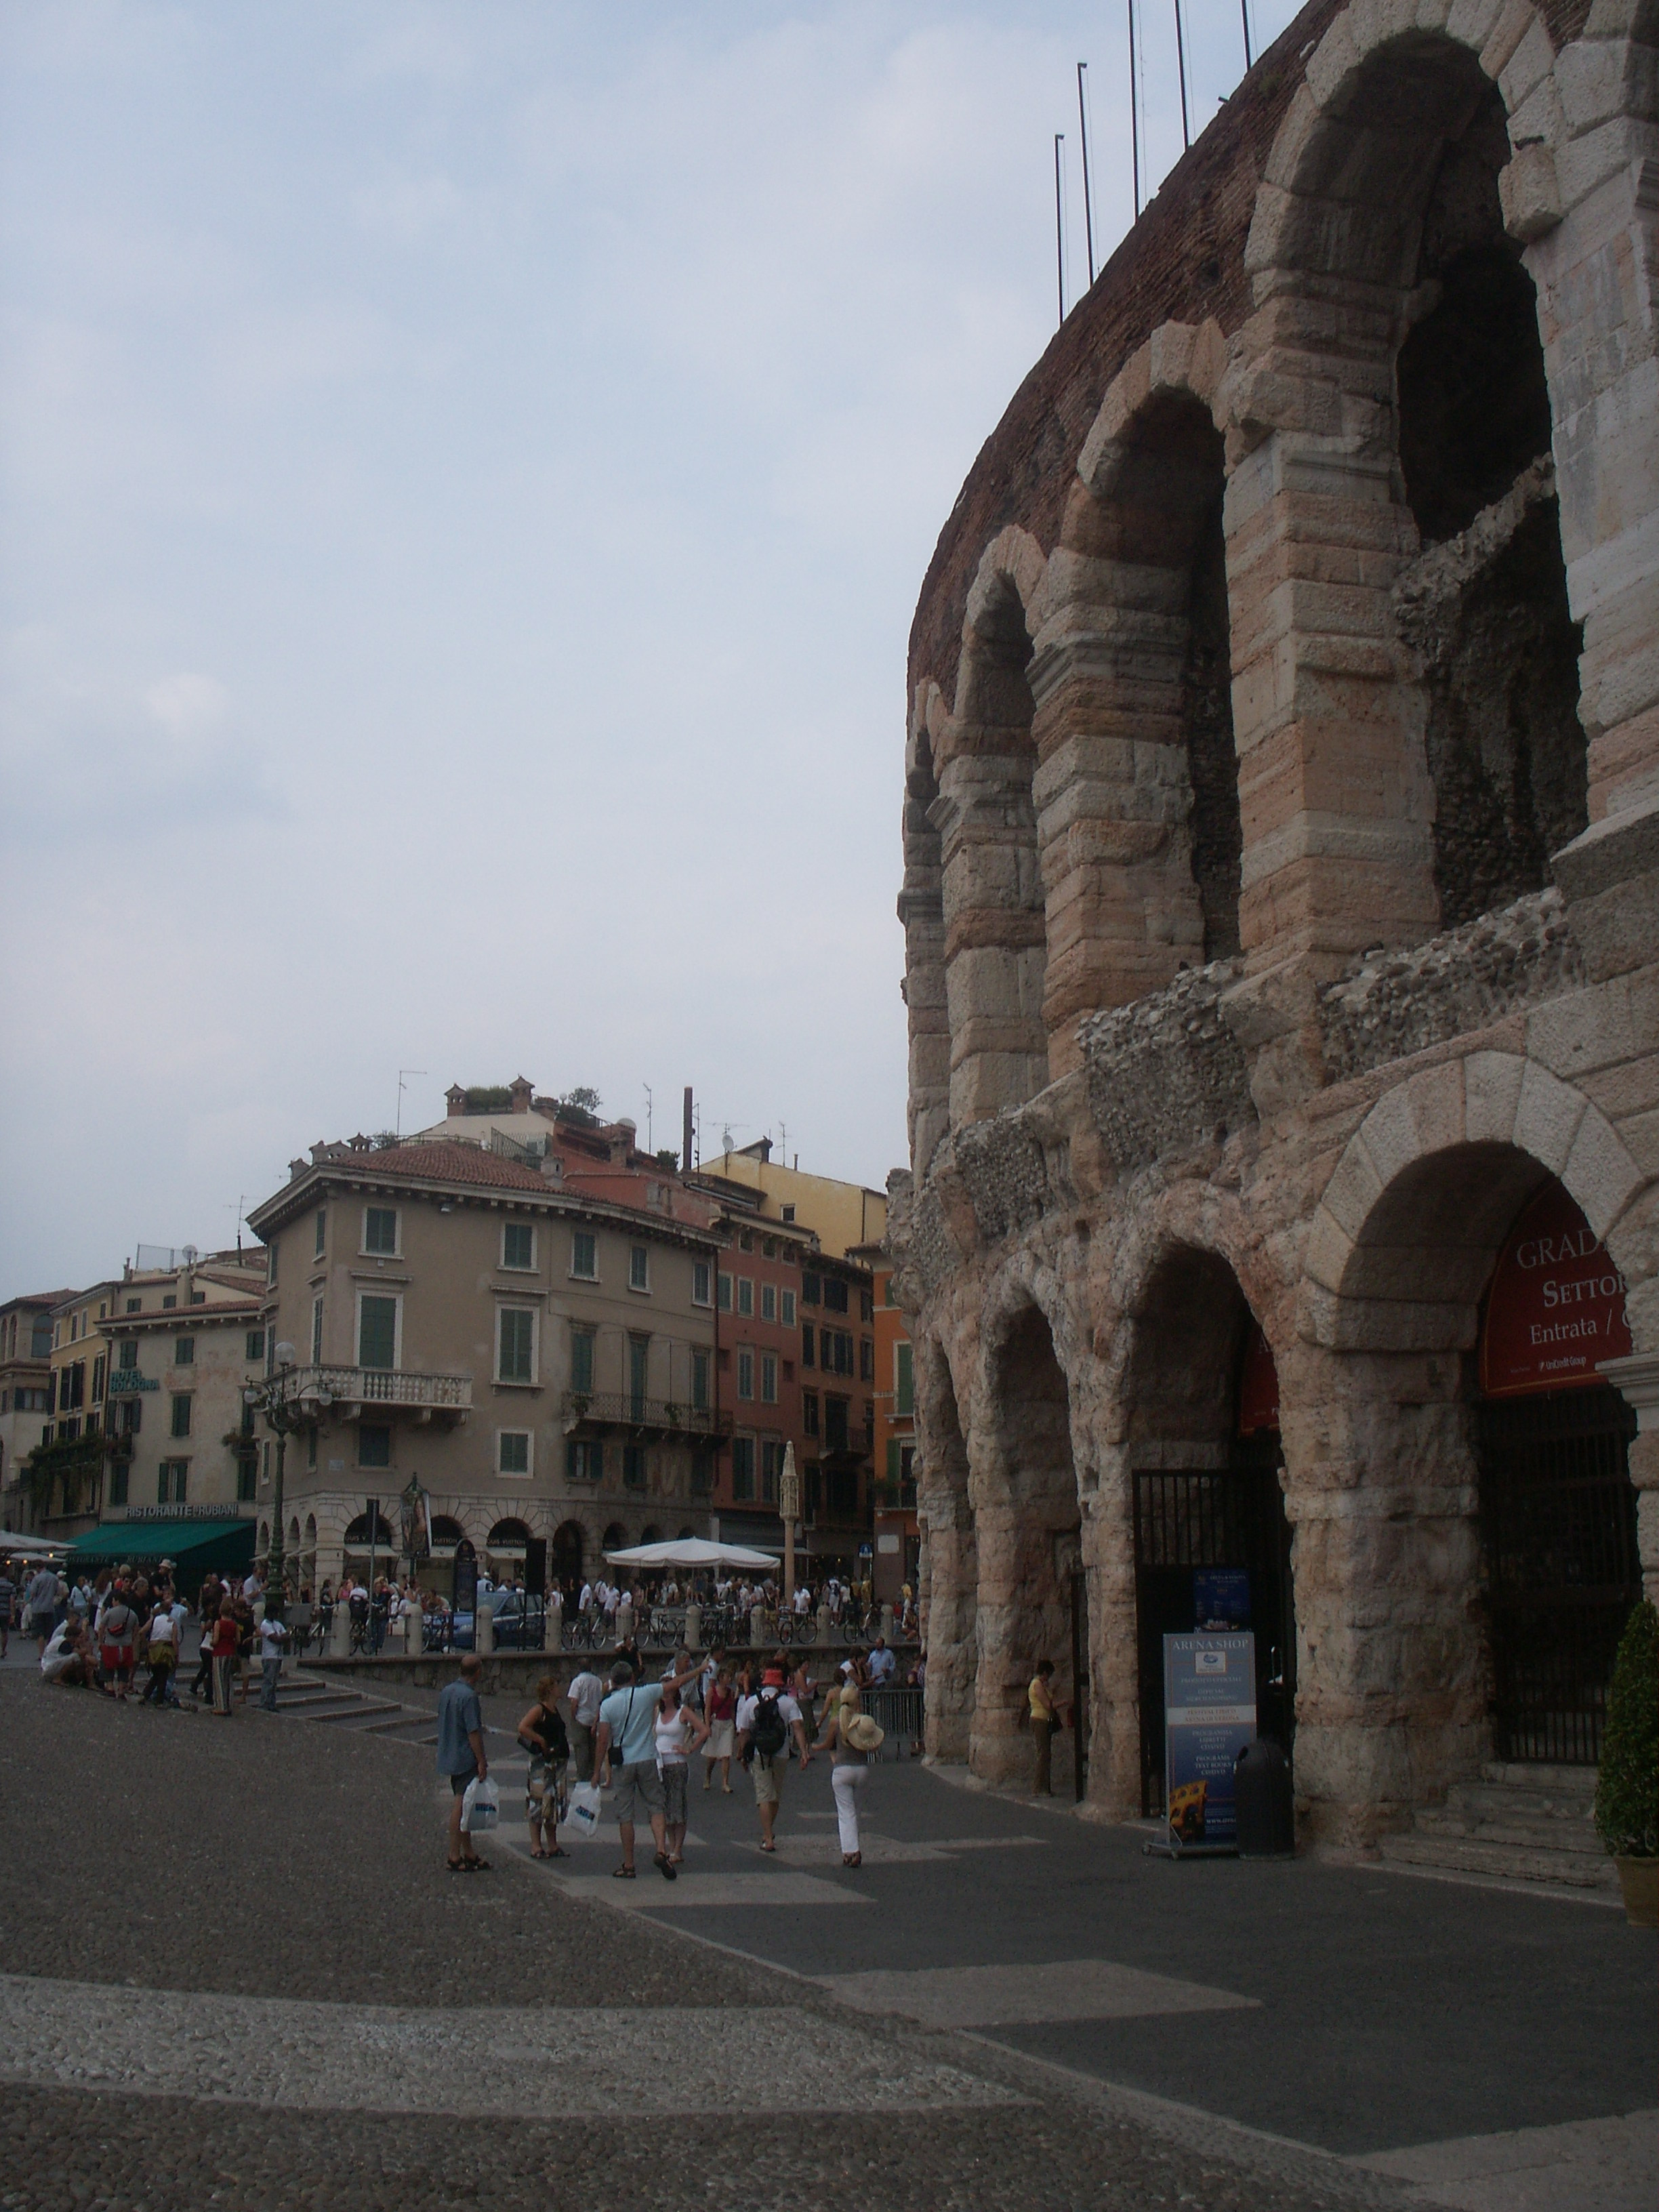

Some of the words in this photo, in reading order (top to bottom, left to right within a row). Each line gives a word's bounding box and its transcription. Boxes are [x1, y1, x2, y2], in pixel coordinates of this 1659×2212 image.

[1517, 1228, 1607, 1269] GRAD
[1529, 1318, 1598, 1345] Entrata
[110, 1370, 142, 1381] HOTEL
[110, 1378, 160, 1392] BOLOGNA
[126, 1504, 192, 1517] RISTORANTE
[199, 1504, 237, 1516] RUBIANI
[66, 1555, 108, 1563] ISTORANTE
[1172, 1640, 1214, 1650] ARENA
[1216, 1639, 1248, 1649] SHOP
